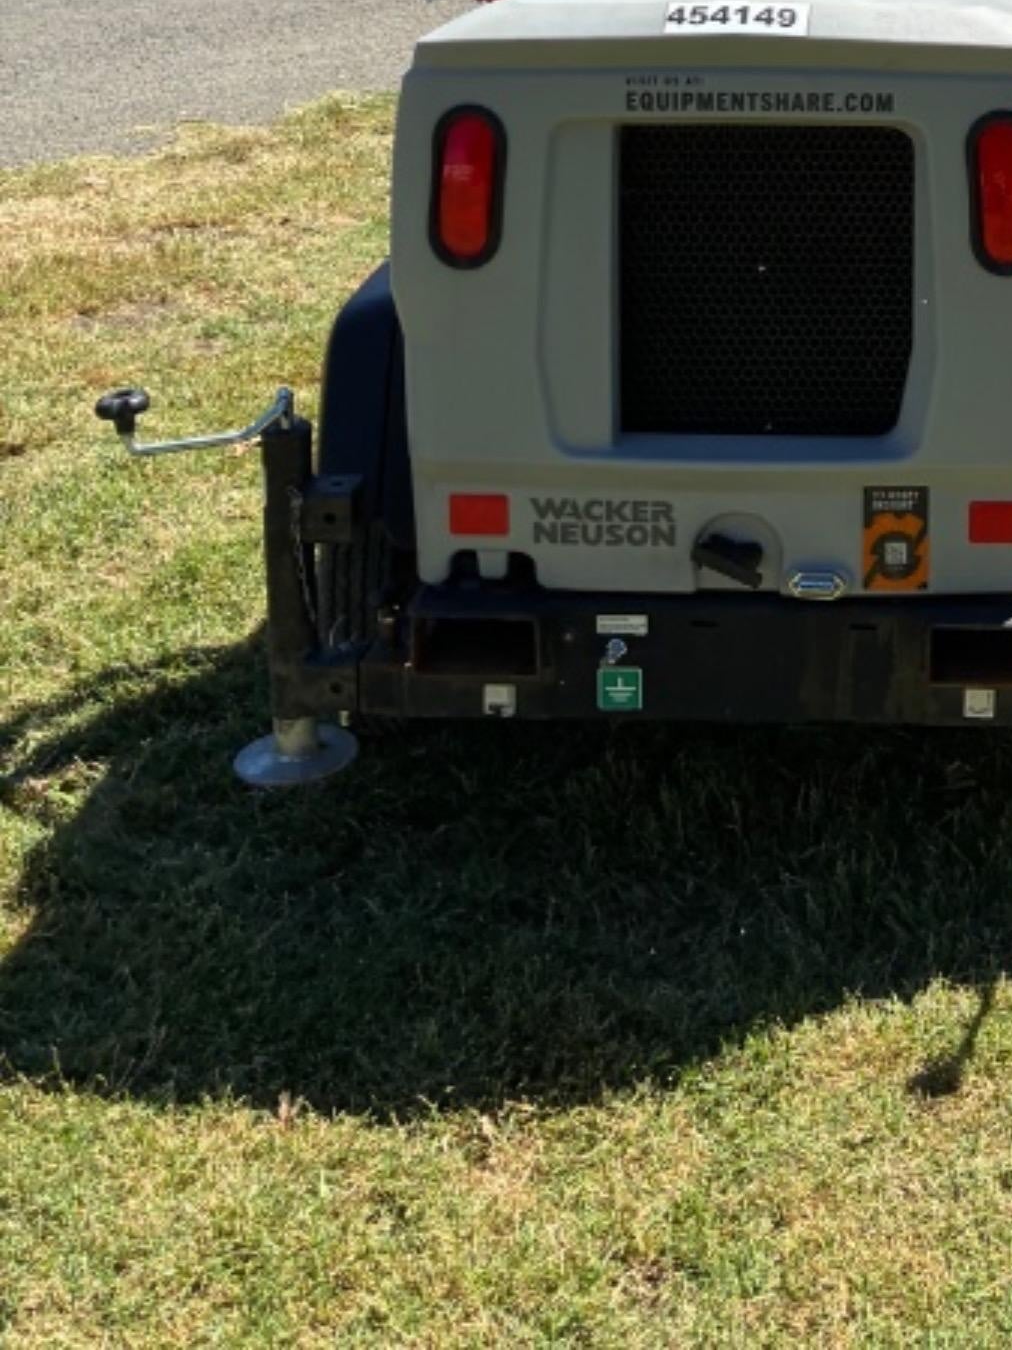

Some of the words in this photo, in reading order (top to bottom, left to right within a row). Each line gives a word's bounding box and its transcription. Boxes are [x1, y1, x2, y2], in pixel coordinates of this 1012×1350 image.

[667, 5, 797, 28] 454149
[625, 91, 895, 113] EQUIPMENTSHARE.COM
[529, 497, 676, 523] WACKER
[533, 521, 676, 547] NEUSON
